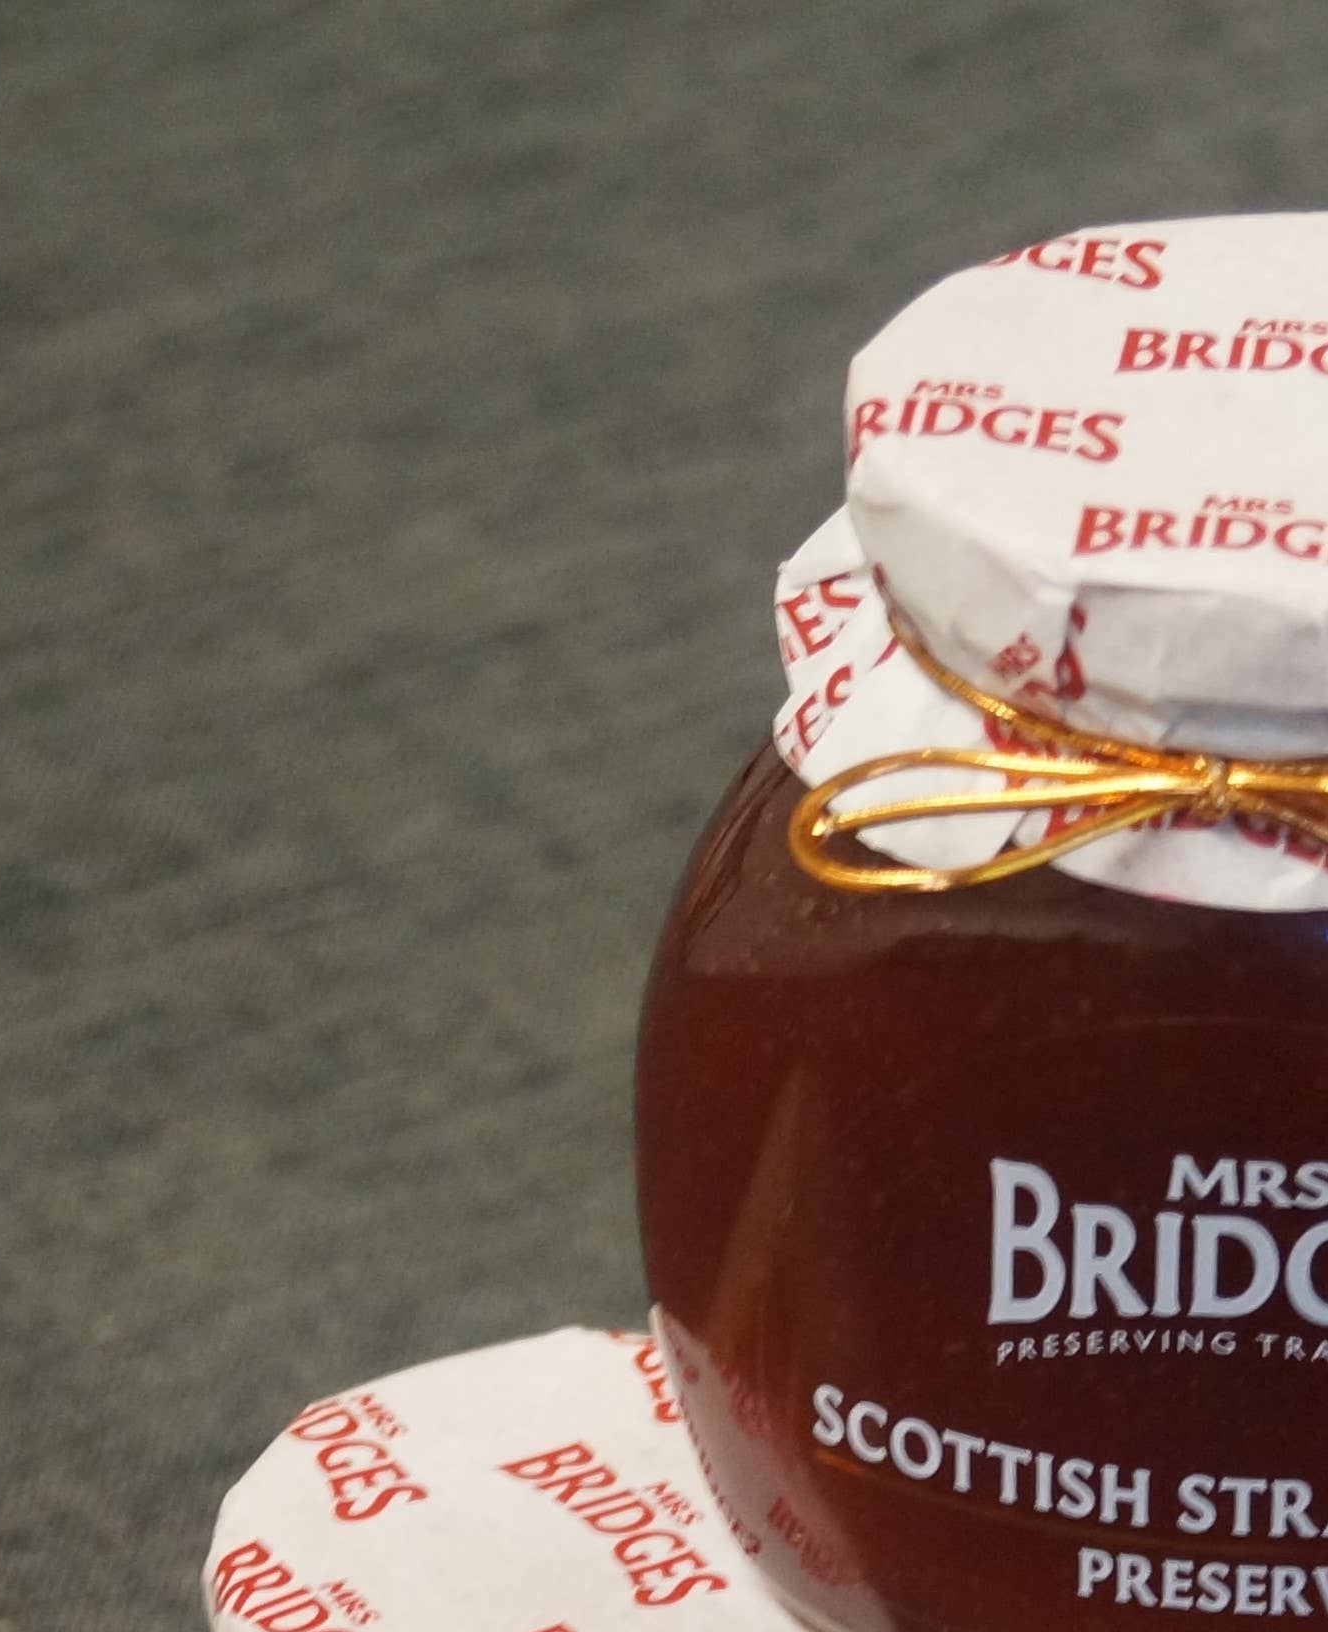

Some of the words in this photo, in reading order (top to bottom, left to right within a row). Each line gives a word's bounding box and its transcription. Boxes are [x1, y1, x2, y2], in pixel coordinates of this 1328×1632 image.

[912, 379, 1006, 399] MRS
[1202, 494, 1296, 515] MRS
[995, 1327, 1238, 1367] PRESERVING
[812, 1384, 1151, 1529] SCOTTISH
[498, 1441, 729, 1607] BRIDGES
[645, 1478, 704, 1526] MRS
[320, 1577, 382, 1626] MRS
